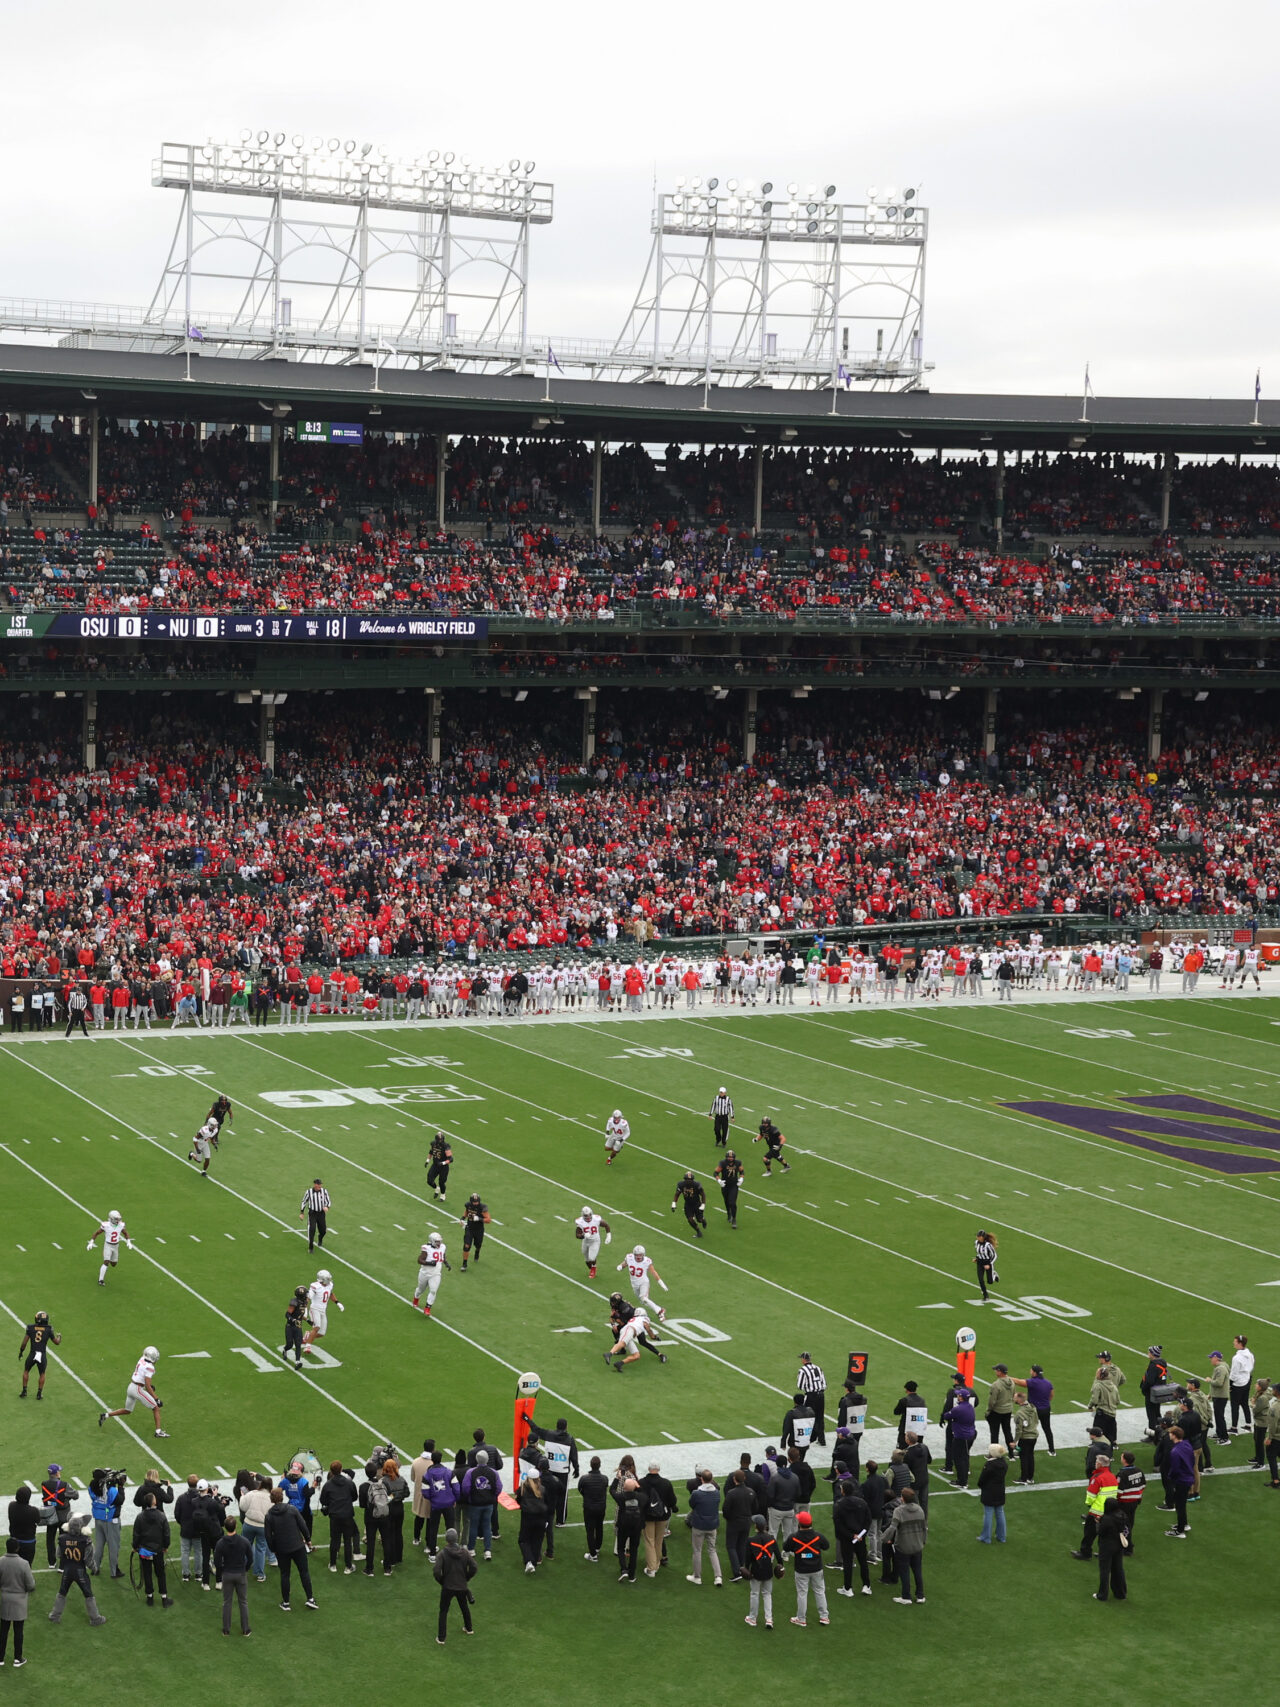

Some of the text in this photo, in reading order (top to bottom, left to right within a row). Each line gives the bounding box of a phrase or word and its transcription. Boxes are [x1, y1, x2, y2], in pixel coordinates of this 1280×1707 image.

[306, 422, 321, 433] 8:13
[12, 616, 27, 628] 1ST
[80, 618, 134, 637] OSU 0
[170, 619, 212, 637] NU 0
[306, 621, 319, 629] BALL
[360, 620, 476, 635] Welcome to WRIGLEY FIELD
[7, 628, 33, 637] QUARTER
[236, 620, 264, 637] DOWN 3
[272, 628, 280, 636] GO
[284, 620, 292, 637] 7
[326, 620, 340, 637] 18
[623, 1047, 694, 1057] 40
[387, 1056, 464, 1066] 30
[139, 1065, 216, 1077] 20
[110, 1231, 118, 1243] 2
[433, 1252, 444, 1262] 91
[630, 1266, 644, 1278] 33
[323, 1291, 329, 1303] 0
[964, 1296, 1093, 1321] 30
[36, 1331, 42, 1342] 8
[230, 1344, 343, 1373] 10
[851, 1356, 865, 1373] 3
[65, 1548, 81, 1561] 00
